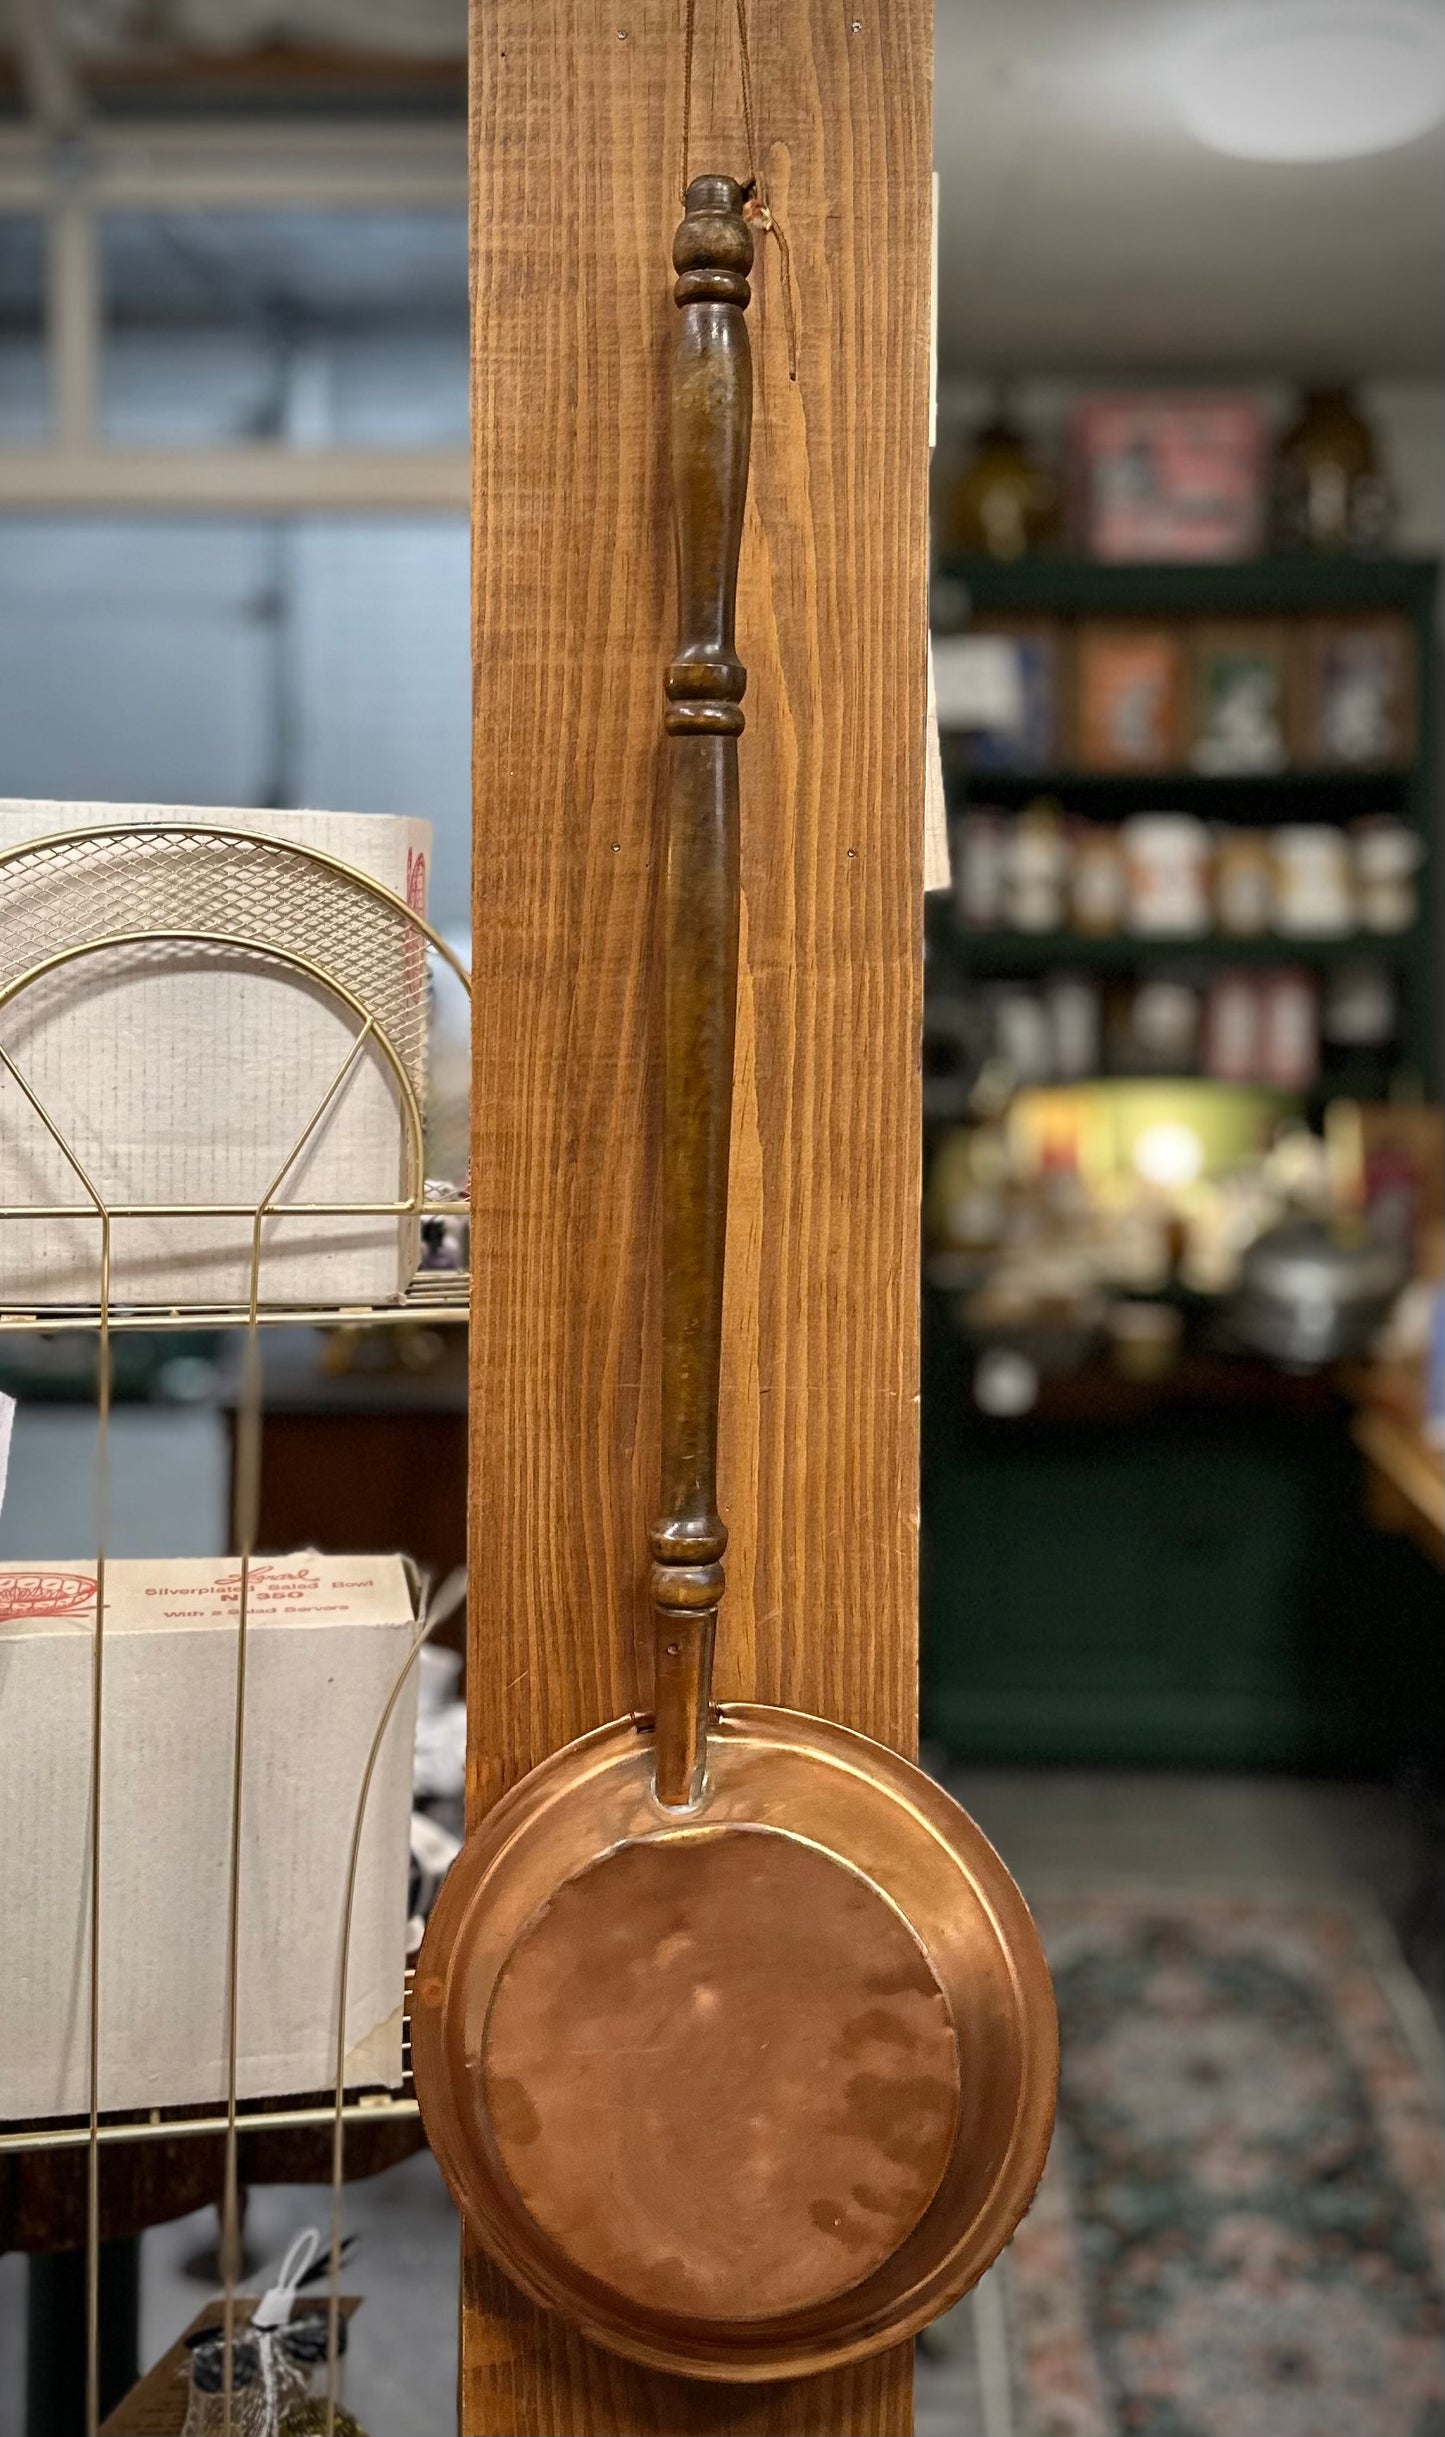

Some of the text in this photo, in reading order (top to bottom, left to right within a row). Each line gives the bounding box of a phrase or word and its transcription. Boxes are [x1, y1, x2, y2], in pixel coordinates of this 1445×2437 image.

[145, 1579, 374, 1596] Silverplated Salad Bowl
[256, 1591, 304, 1600] 350
[284, 1605, 349, 1613] Servers
